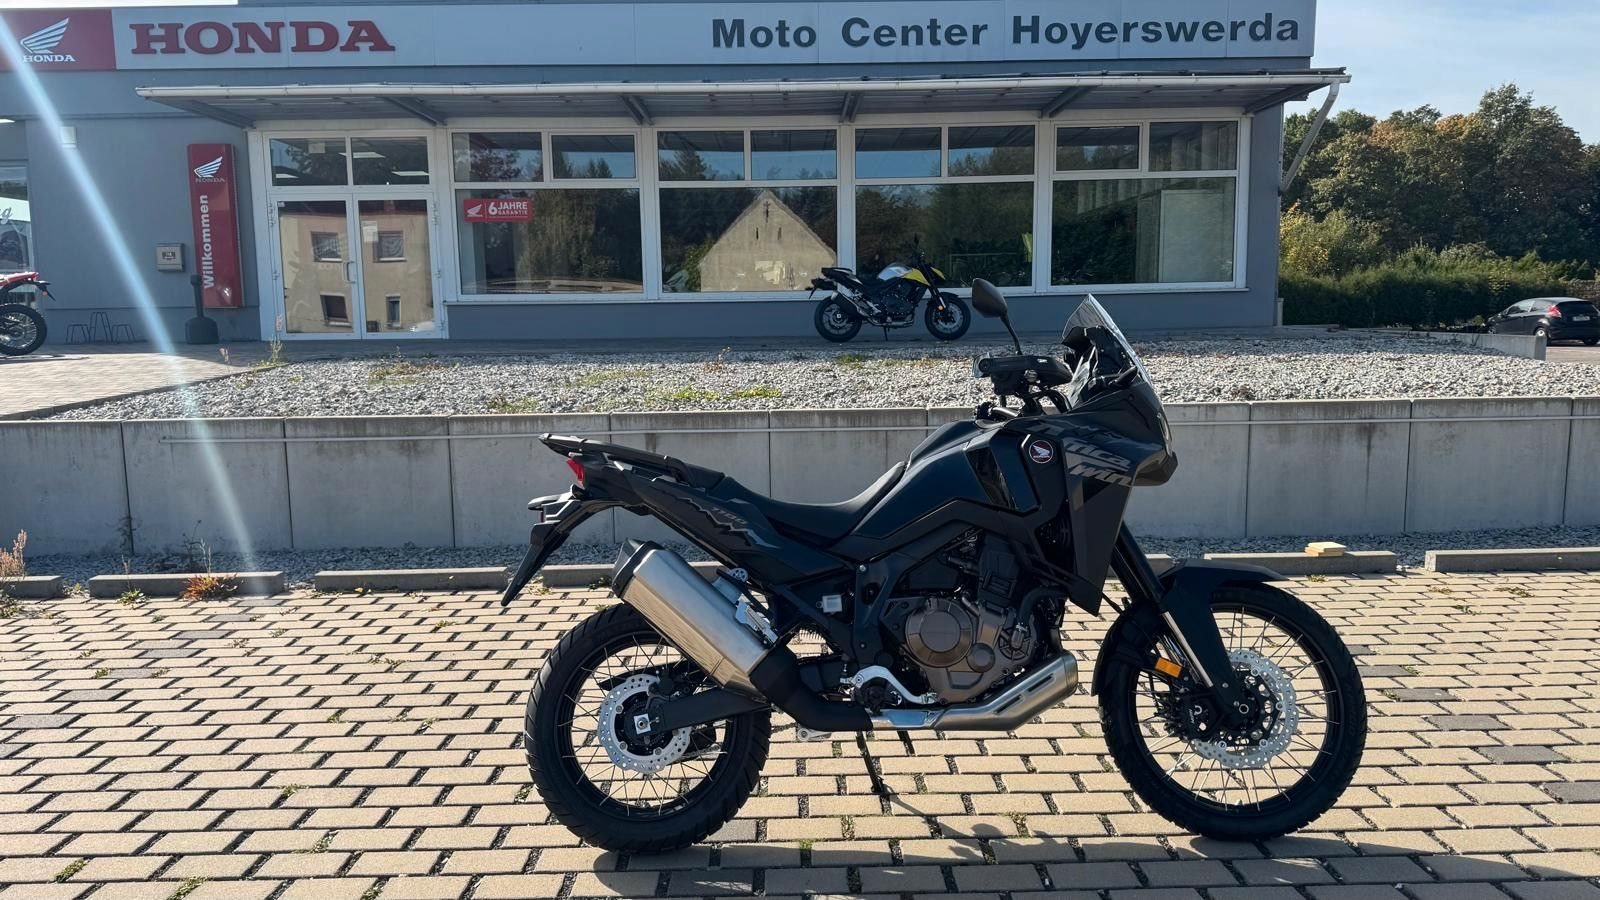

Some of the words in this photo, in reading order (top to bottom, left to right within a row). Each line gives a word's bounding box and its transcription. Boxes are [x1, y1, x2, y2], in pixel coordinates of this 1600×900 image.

[129, 20, 396, 54] HONDA
[712, 18, 817, 48] Moto
[841, 17, 988, 47] Center
[1012, 12, 1299, 50] Hoyerswerda
[22, 54, 76, 63] HONDA
[488, 202, 498, 216] 6
[498, 201, 528, 210] JAHRE
[199, 194, 215, 289] Willkommen
